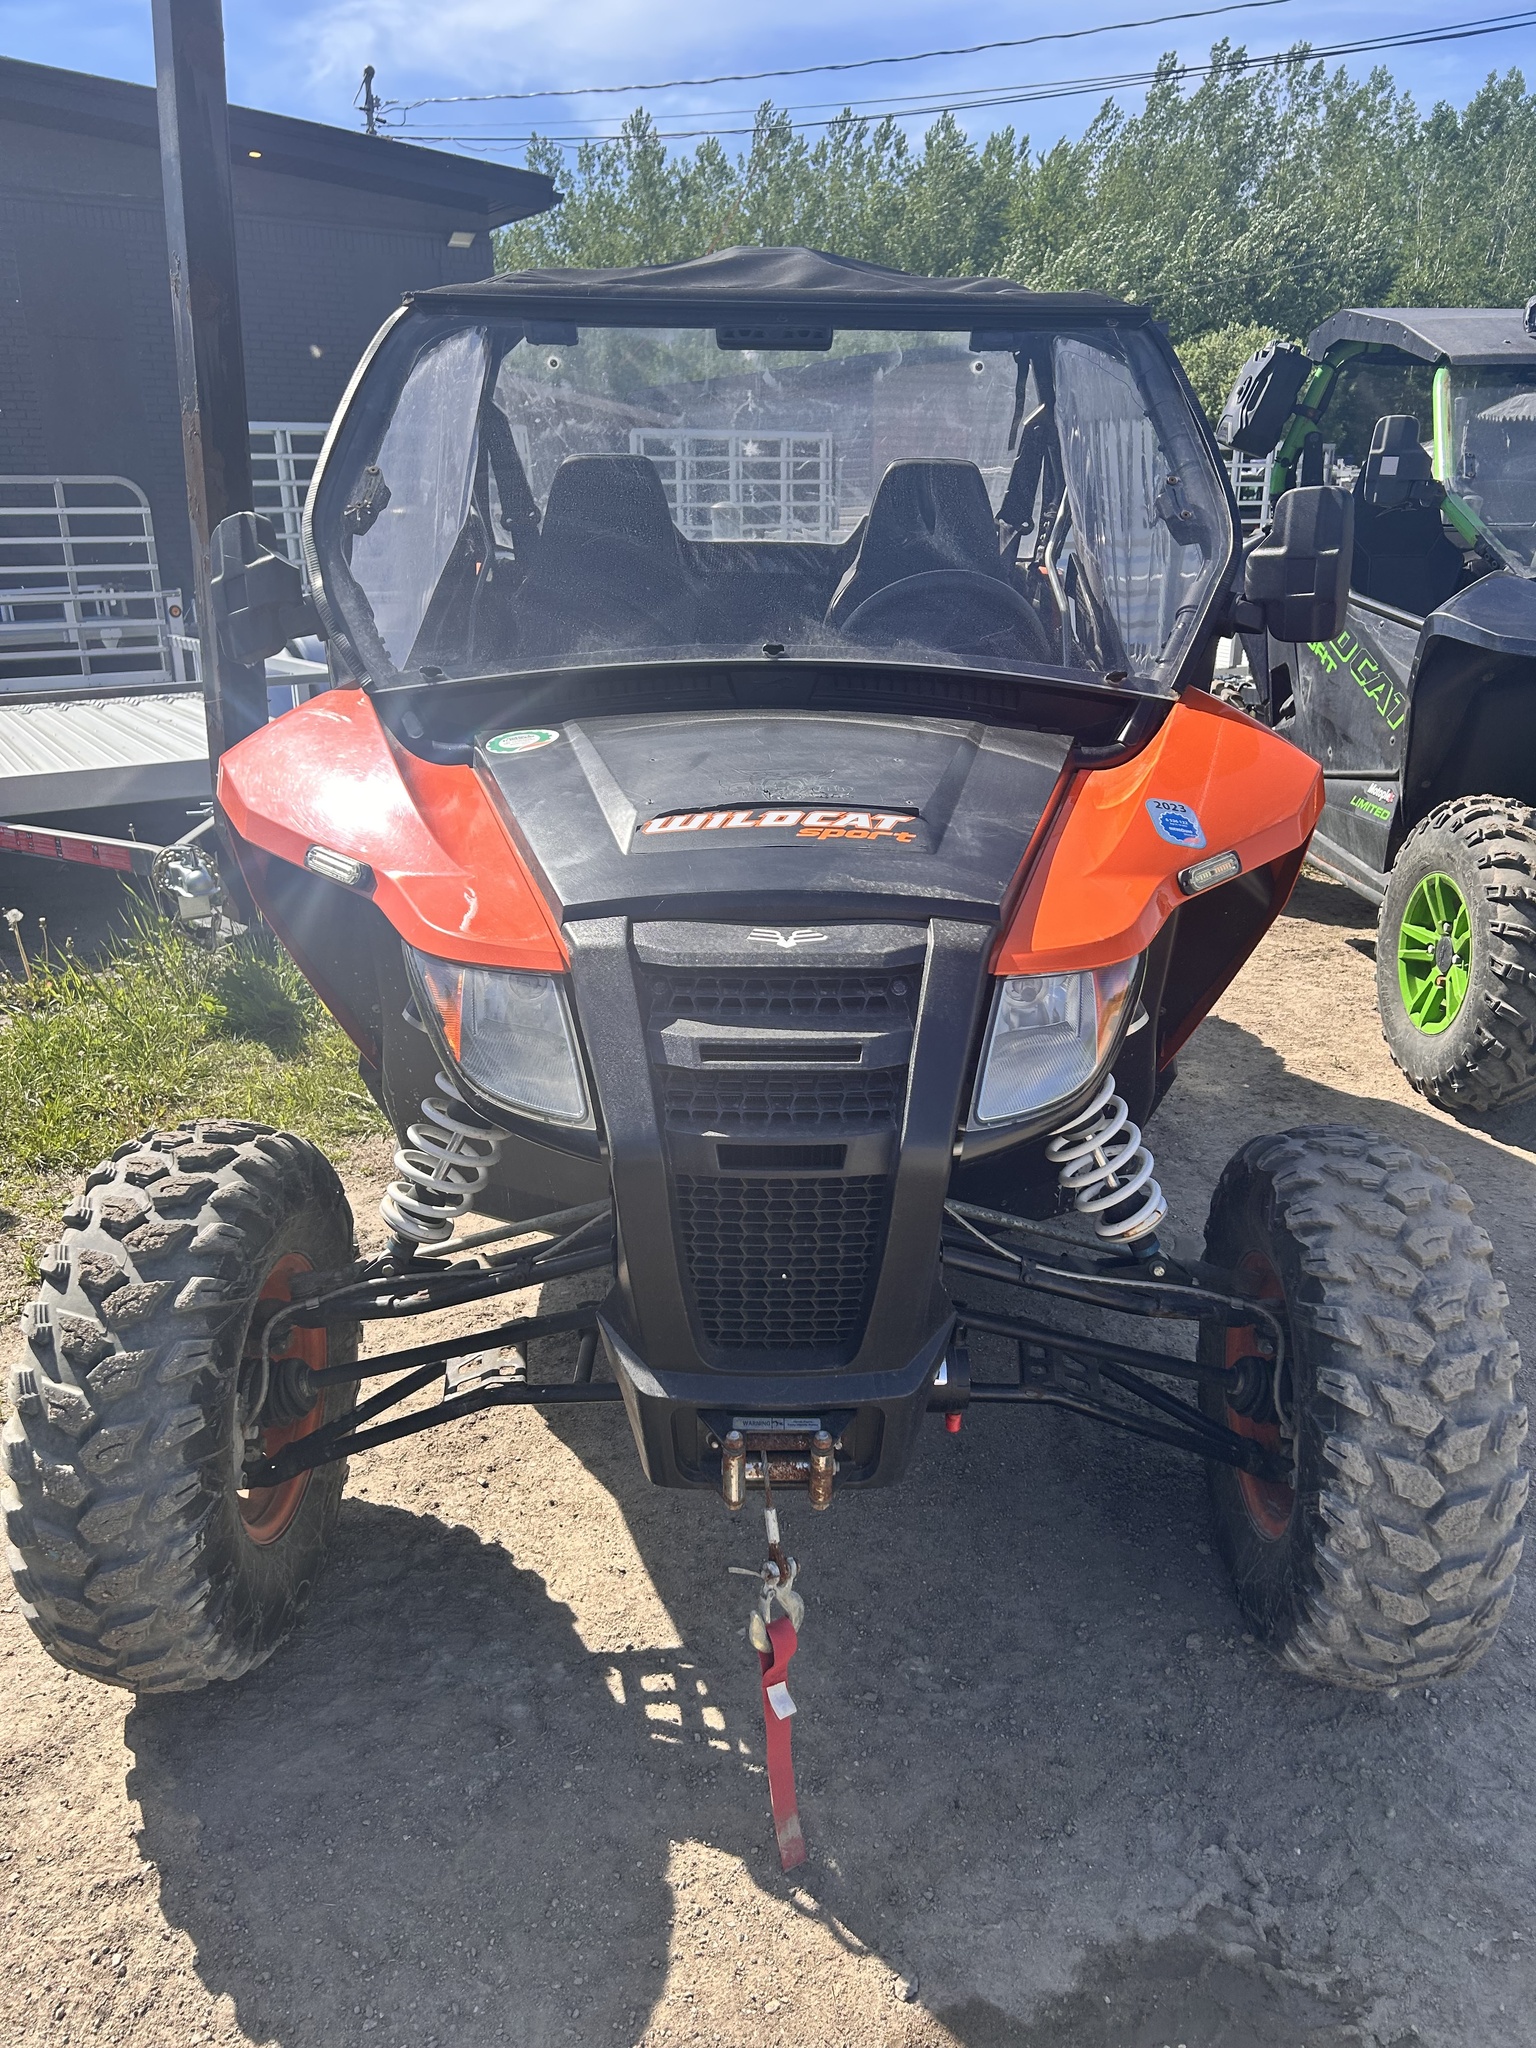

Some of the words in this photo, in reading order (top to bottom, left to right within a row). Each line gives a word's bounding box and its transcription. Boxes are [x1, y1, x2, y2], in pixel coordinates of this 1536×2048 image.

[1329, 626, 1406, 730] DCAT
[1153, 800, 1187, 812] 2023
[1350, 795, 1391, 820] LIMITED
[641, 810, 917, 835] WILDCAT
[795, 828, 917, 843] sport
